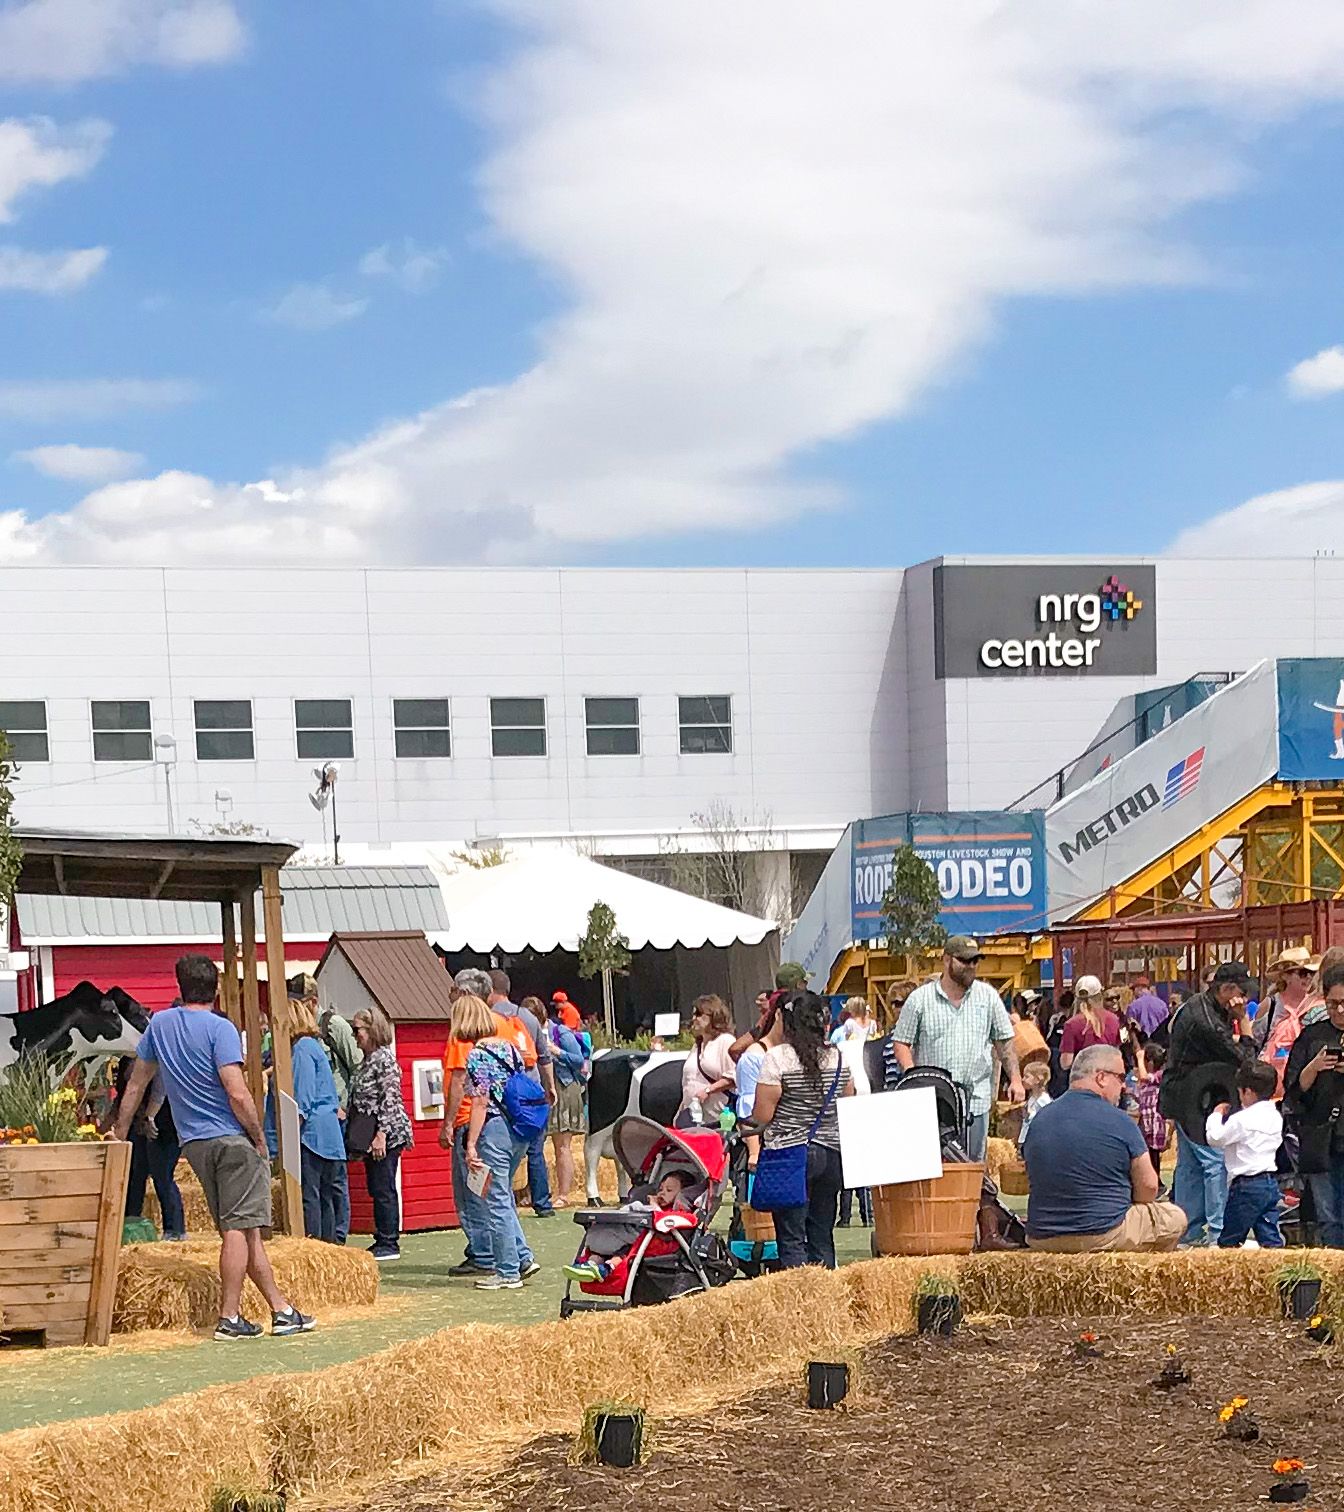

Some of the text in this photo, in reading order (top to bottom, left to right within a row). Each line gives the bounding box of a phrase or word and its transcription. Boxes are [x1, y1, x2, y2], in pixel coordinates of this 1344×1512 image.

[1039, 593, 1100, 632] nrg
[981, 632, 1100, 668] center
[1057, 782, 1161, 865] METRO
